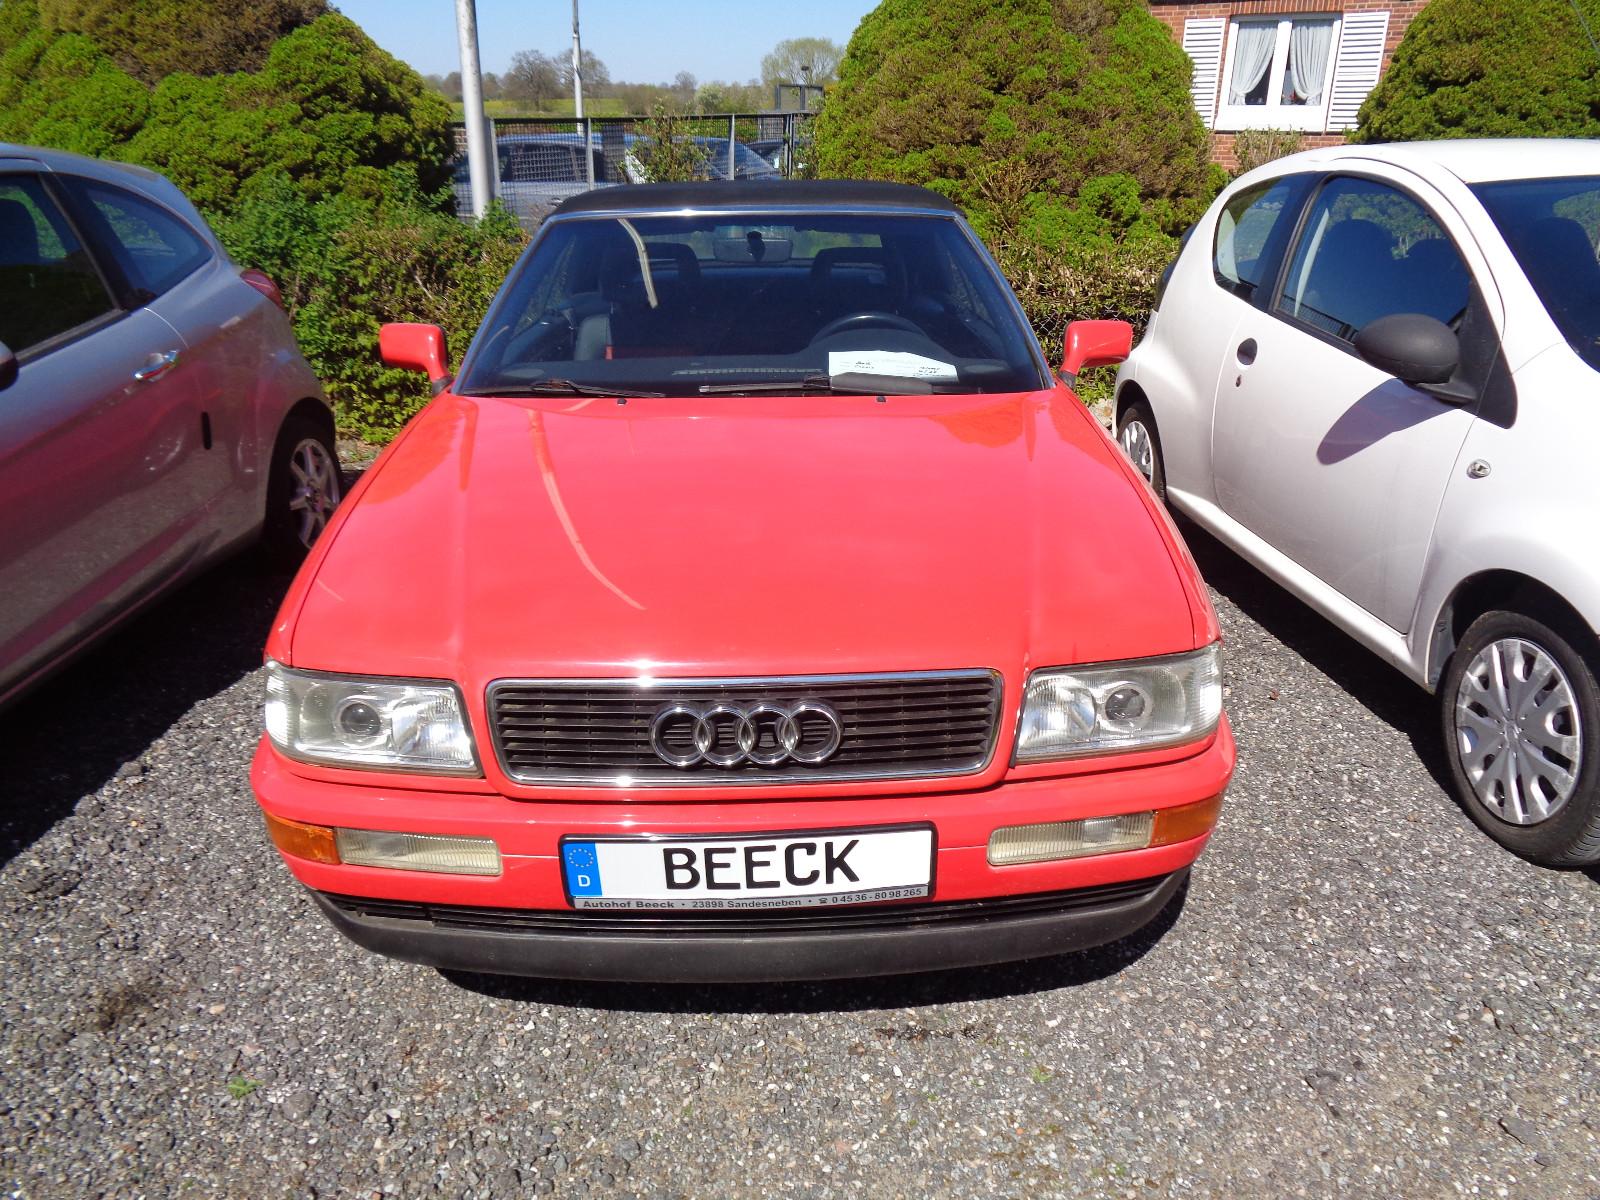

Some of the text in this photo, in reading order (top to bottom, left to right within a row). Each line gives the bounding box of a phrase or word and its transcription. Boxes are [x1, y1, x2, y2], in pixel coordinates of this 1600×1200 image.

[662, 839, 861, 890] BEECK
[577, 874, 591, 887] D
[583, 900, 631, 908] Autohof
[636, 900, 675, 908] Beeck
[692, 900, 724, 908] 23898
[727, 899, 801, 908] Sandesneben
